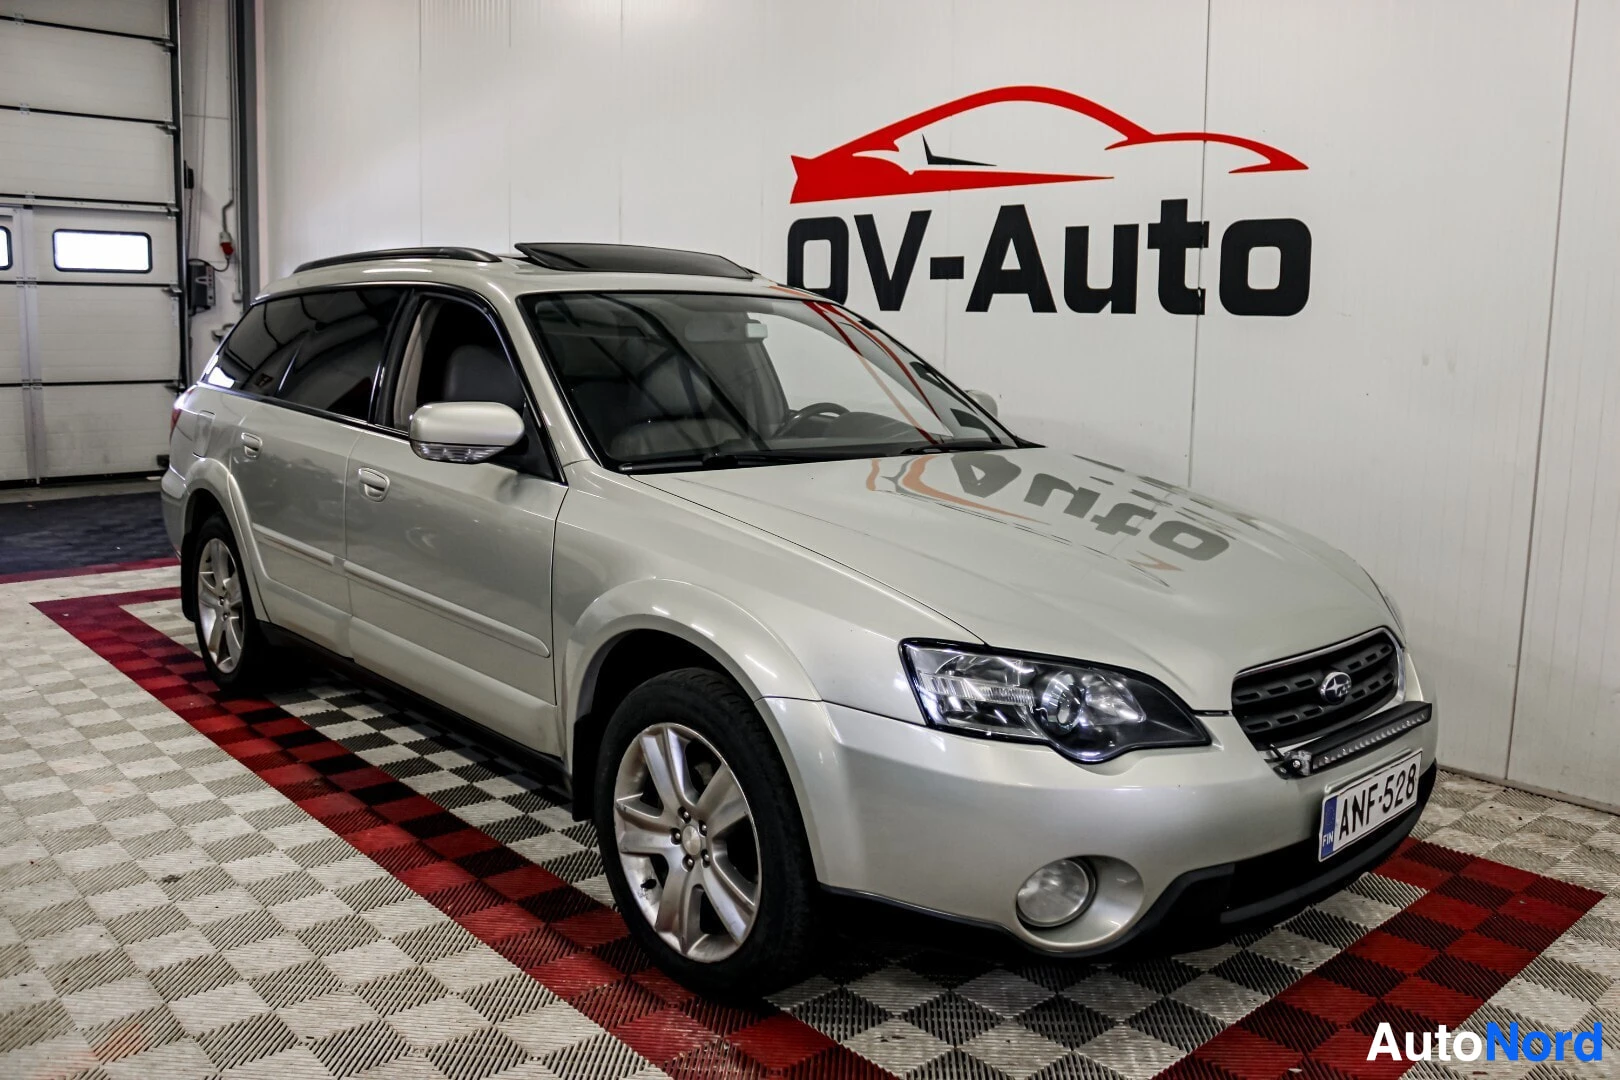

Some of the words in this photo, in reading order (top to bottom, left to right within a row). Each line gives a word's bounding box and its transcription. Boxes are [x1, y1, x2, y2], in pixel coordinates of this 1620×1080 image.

[787, 199, 1312, 316] OV-Auto
[1322, 831, 1334, 847] FIN
[1339, 763, 1417, 841] ANF-528
